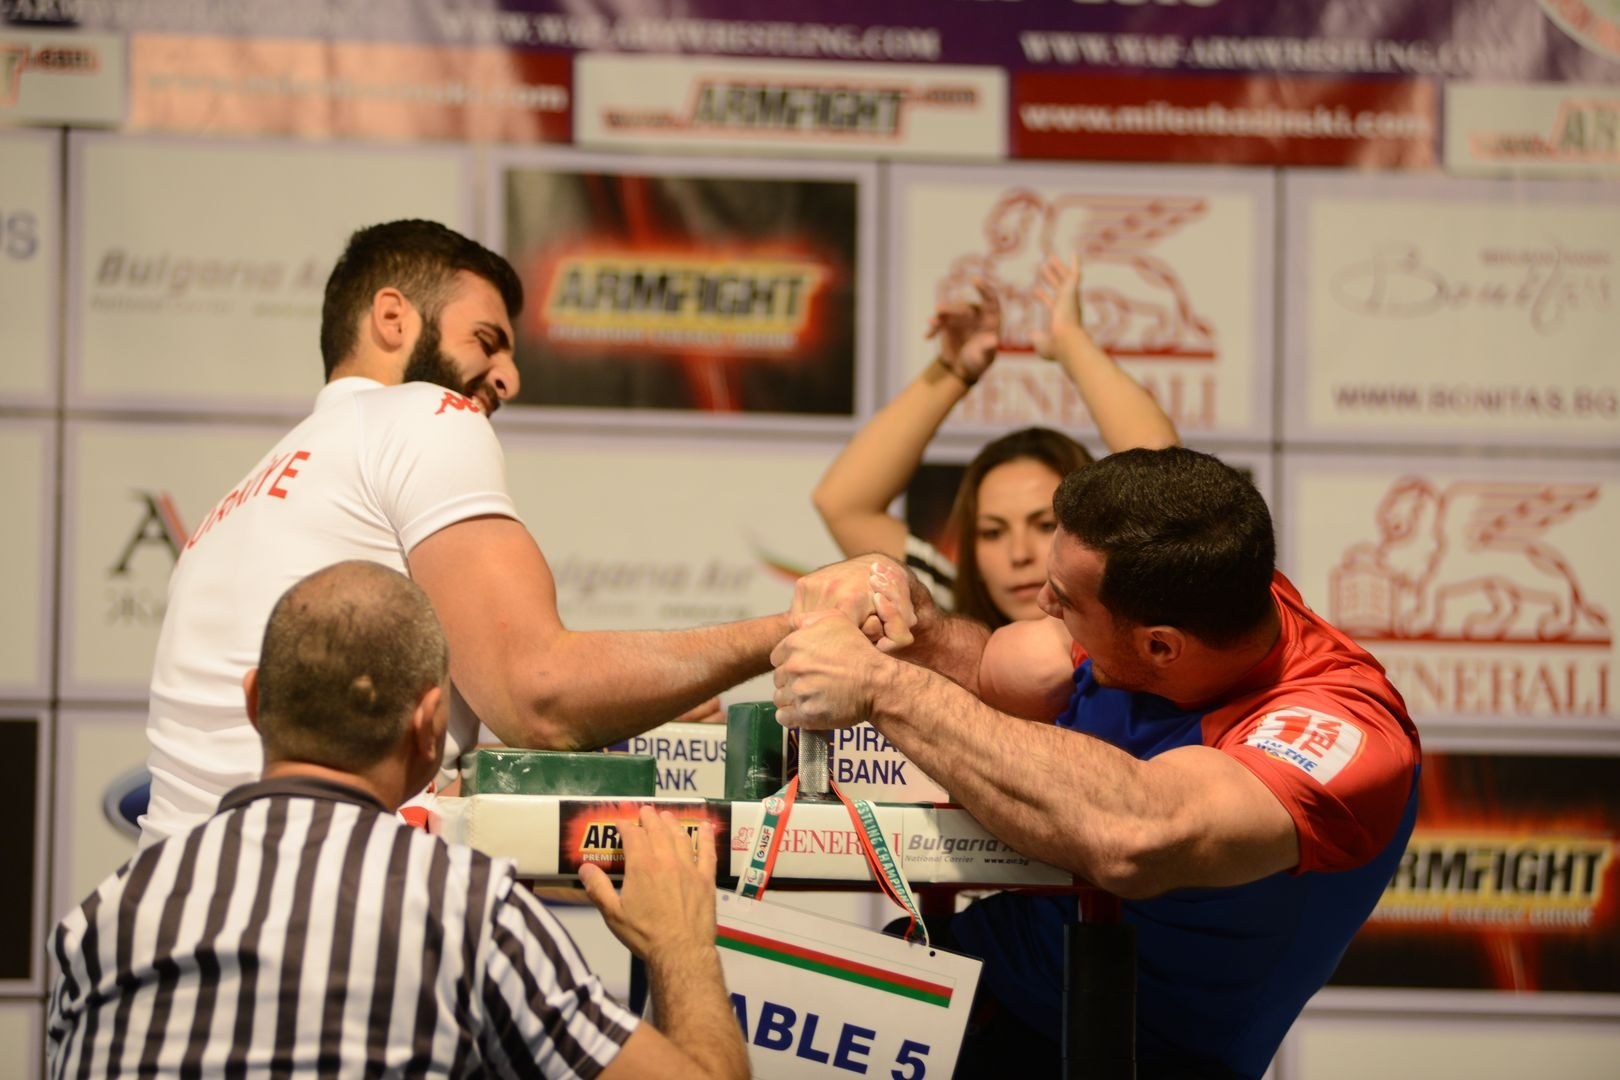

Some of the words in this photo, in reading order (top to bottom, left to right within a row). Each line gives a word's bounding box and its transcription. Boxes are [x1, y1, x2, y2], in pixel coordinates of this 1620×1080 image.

[1383, 661, 1609, 715] NERALI
[634, 736, 727, 761] PIRAEUS
[655, 768, 697, 791] ANK
[838, 758, 906, 785] BANK
[1388, 849, 1605, 894] RMFIGHT
[890, 1039, 931, 1080] 5
